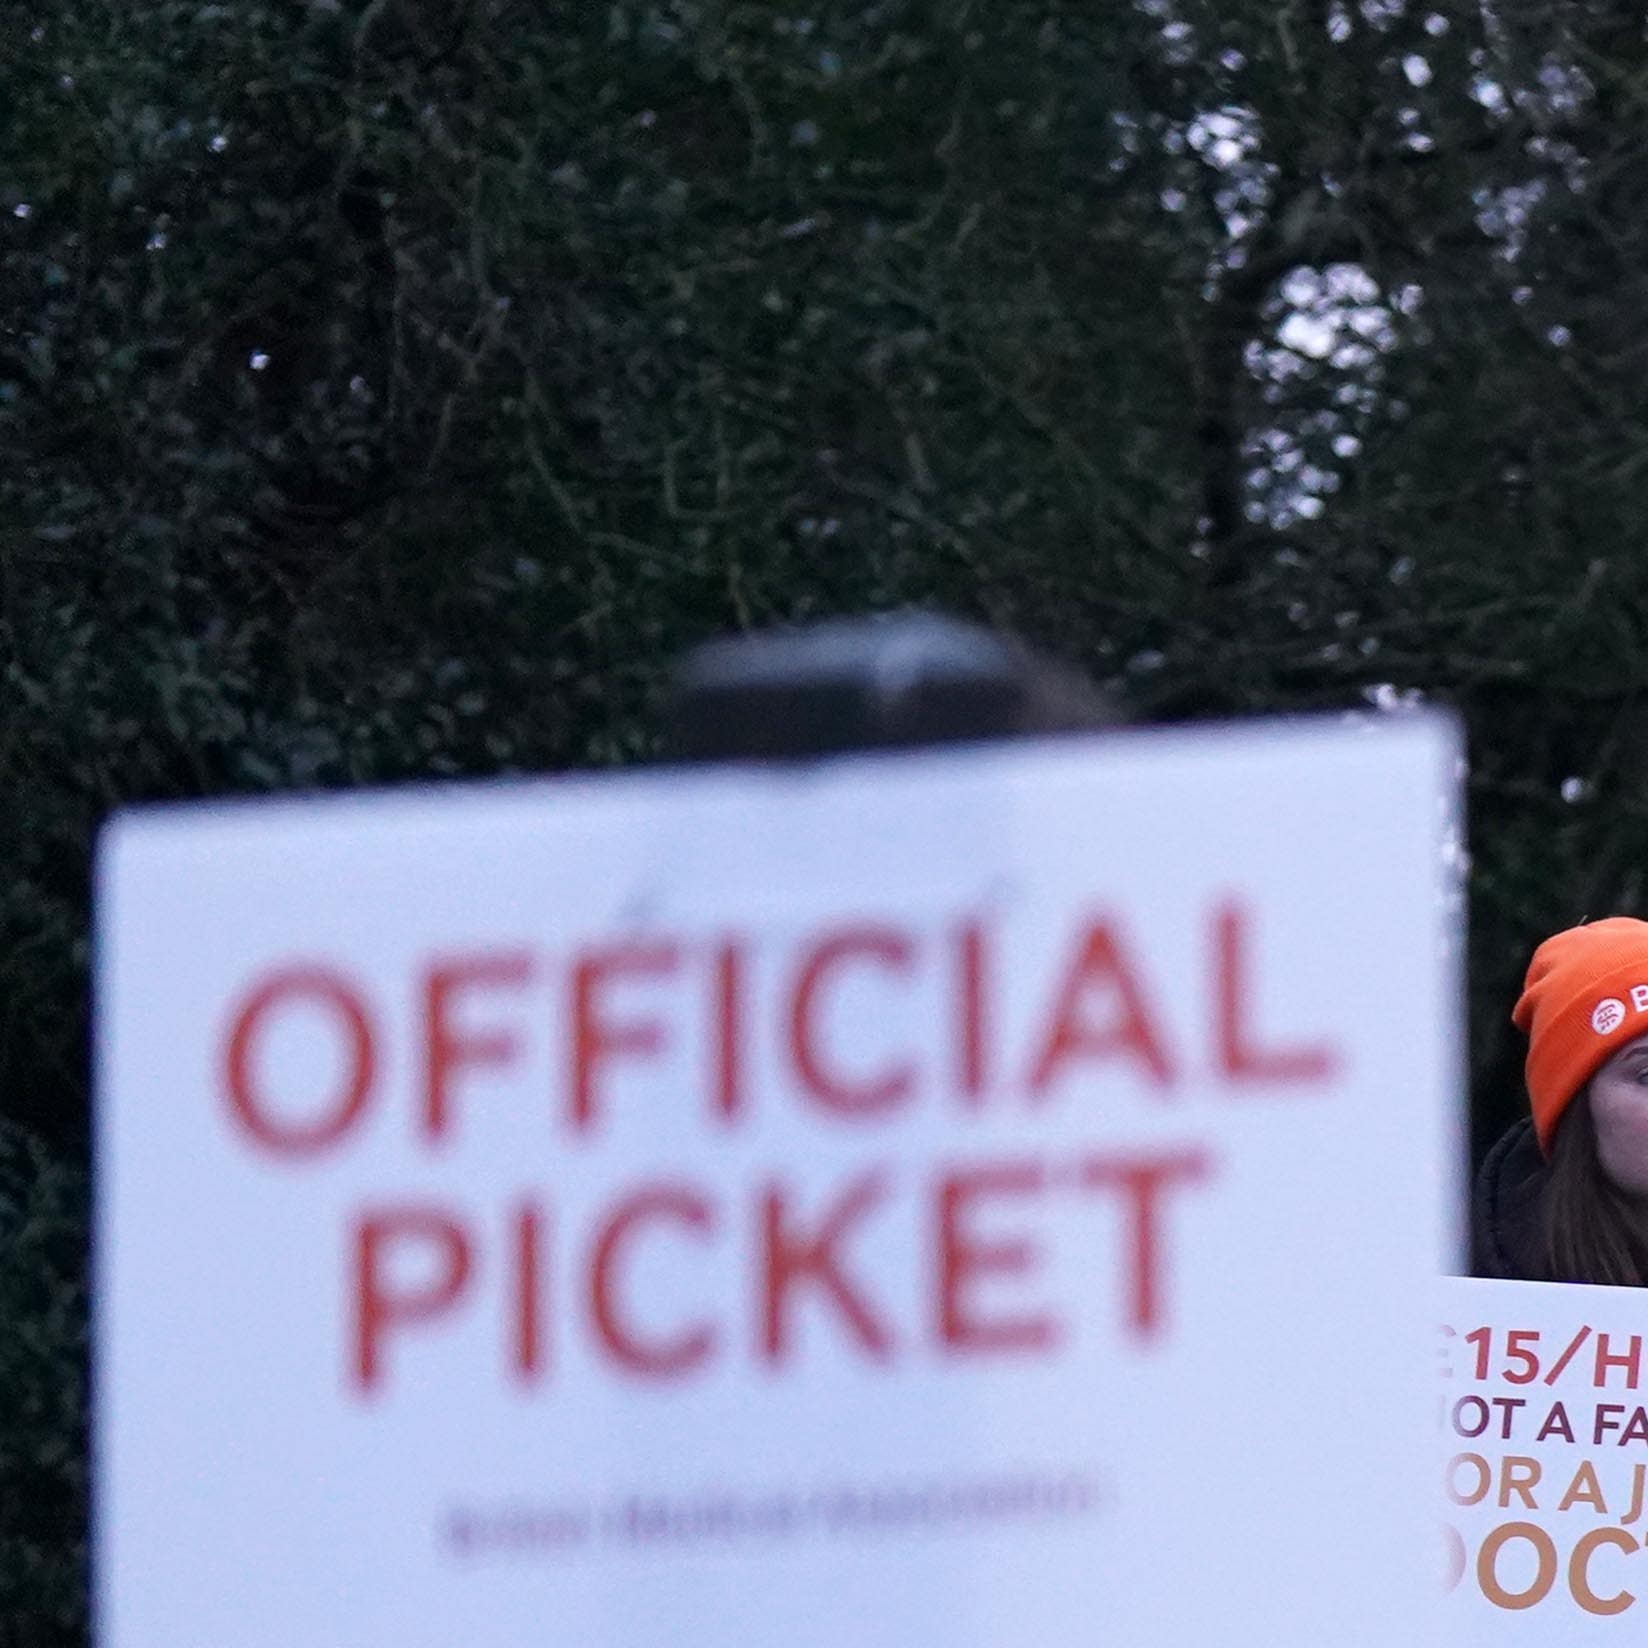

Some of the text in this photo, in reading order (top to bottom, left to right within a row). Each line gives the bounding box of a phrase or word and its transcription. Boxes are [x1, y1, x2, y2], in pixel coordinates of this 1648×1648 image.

[223, 887, 1342, 1160] OFFICIAL
[346, 1145, 1216, 1406] PICKET
[1442, 1395, 1527, 1440] OT
[1536, 1401, 1575, 1443] A
[1444, 1452, 1539, 1509] OR
[1557, 1460, 1608, 1513] A
